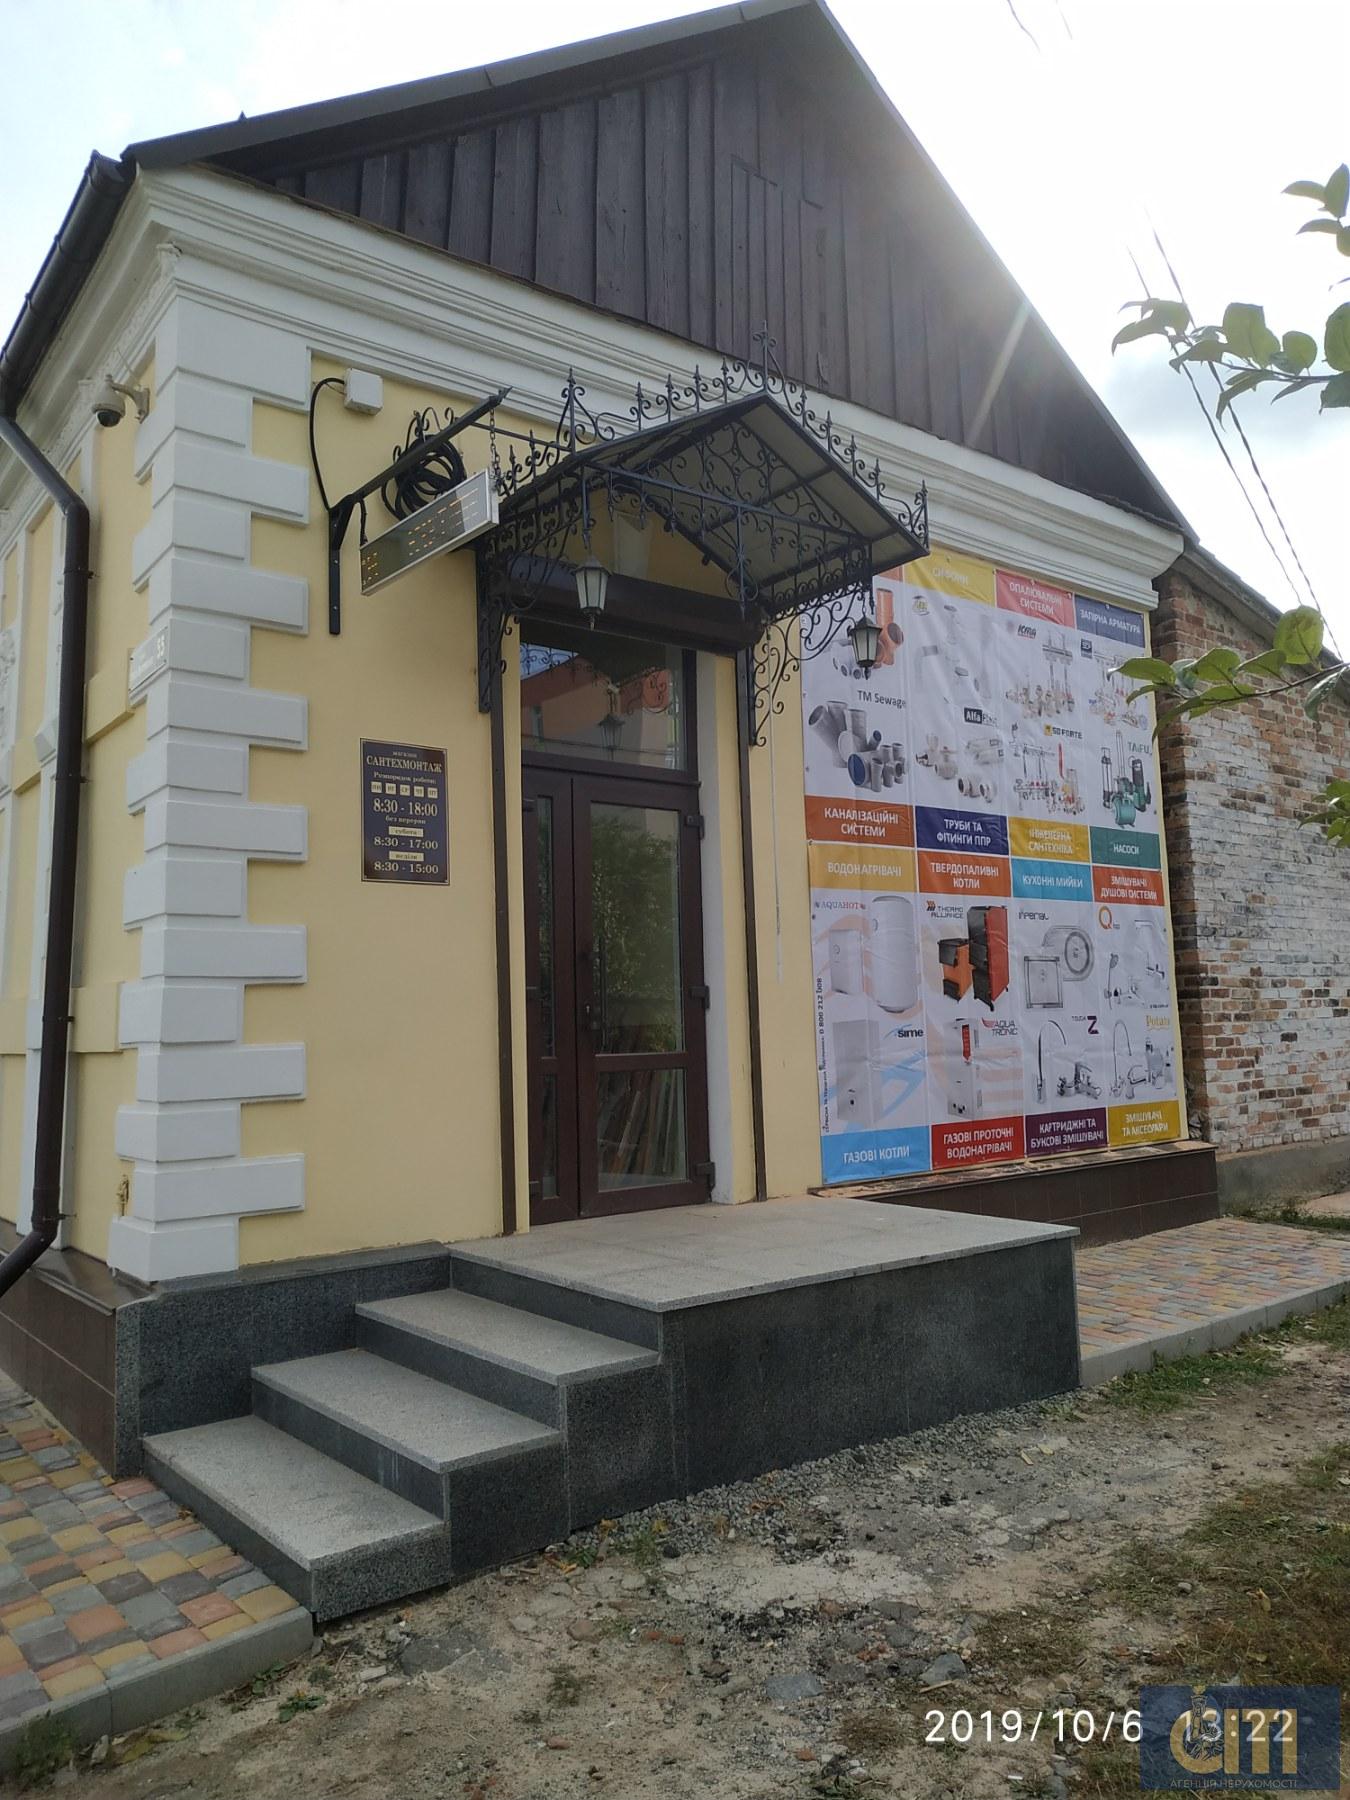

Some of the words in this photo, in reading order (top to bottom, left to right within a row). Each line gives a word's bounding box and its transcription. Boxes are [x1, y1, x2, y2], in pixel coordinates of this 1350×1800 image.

[1019, 598, 1055, 616] СИСТЕМИ
[1079, 608, 1108, 626] ЗАПІРНА
[1107, 614, 1142, 634] АРМАТУРА
[857, 690, 873, 702] TM
[873, 692, 907, 709] Sewage
[366, 755, 442, 774] САНТЕХМОНТАЖ
[373, 797, 399, 814] 8:30
[408, 801, 438, 817] 18:00
[823, 807, 899, 825] КАНАЛІЗАЦІЙНІ
[840, 823, 886, 837] СИСТЕМИ
[943, 818, 971, 832] ТРУБИ
[971, 821, 983, 832] ТА
[373, 836, 399, 847] 8:30
[409, 839, 439, 850] 17:00
[936, 831, 973, 845] ФІТИНГИ
[974, 834, 992, 846] ППР
[1028, 841, 1073, 854] САНТЕХНІКА
[1113, 843, 1140, 855] НАСОСИ
[373, 861, 400, 872] 8:30
[409, 863, 440, 874] 15:00
[827, 861, 902, 877] ВОДОНАГРІВАЧІ
[930, 862, 999, 877] ТВЕРДОПАЛИВНІ
[953, 877, 980, 889] КОТЛИ
[1022, 875, 1056, 887] КУХОННІ
[1056, 875, 1084, 889] МИЙКИ
[1111, 875, 1148, 888] ЗМІШУВАЧІ
[1101, 887, 1128, 898] ДУШОВІ
[1128, 889, 1158, 901] СИСТЕМИ
[821, 900, 861, 911] AQUAHOT
[994, 1020, 1016, 1028] AQUA
[897, 1028, 924, 1038] sime
[992, 1028, 1019, 1036] TRONIC
[1039, 1120, 1086, 1134] КАРТРИДЖНІ
[1086, 1118, 1097, 1128] ТА
[943, 1131, 972, 1145] ГАЗОВІ
[973, 1126, 1015, 1142] ПРОТОЧНІ
[1030, 1135, 1062, 1149] БУКСОВІ
[1062, 1130, 1104, 1145] ЗМІШУВАЧІ
[843, 1151, 877, 1165] ГАЗОВІ
[879, 1146, 910, 1160] КОТЛИ
[946, 1141, 1013, 1160] ВОДОНАГРІВАЧІ
